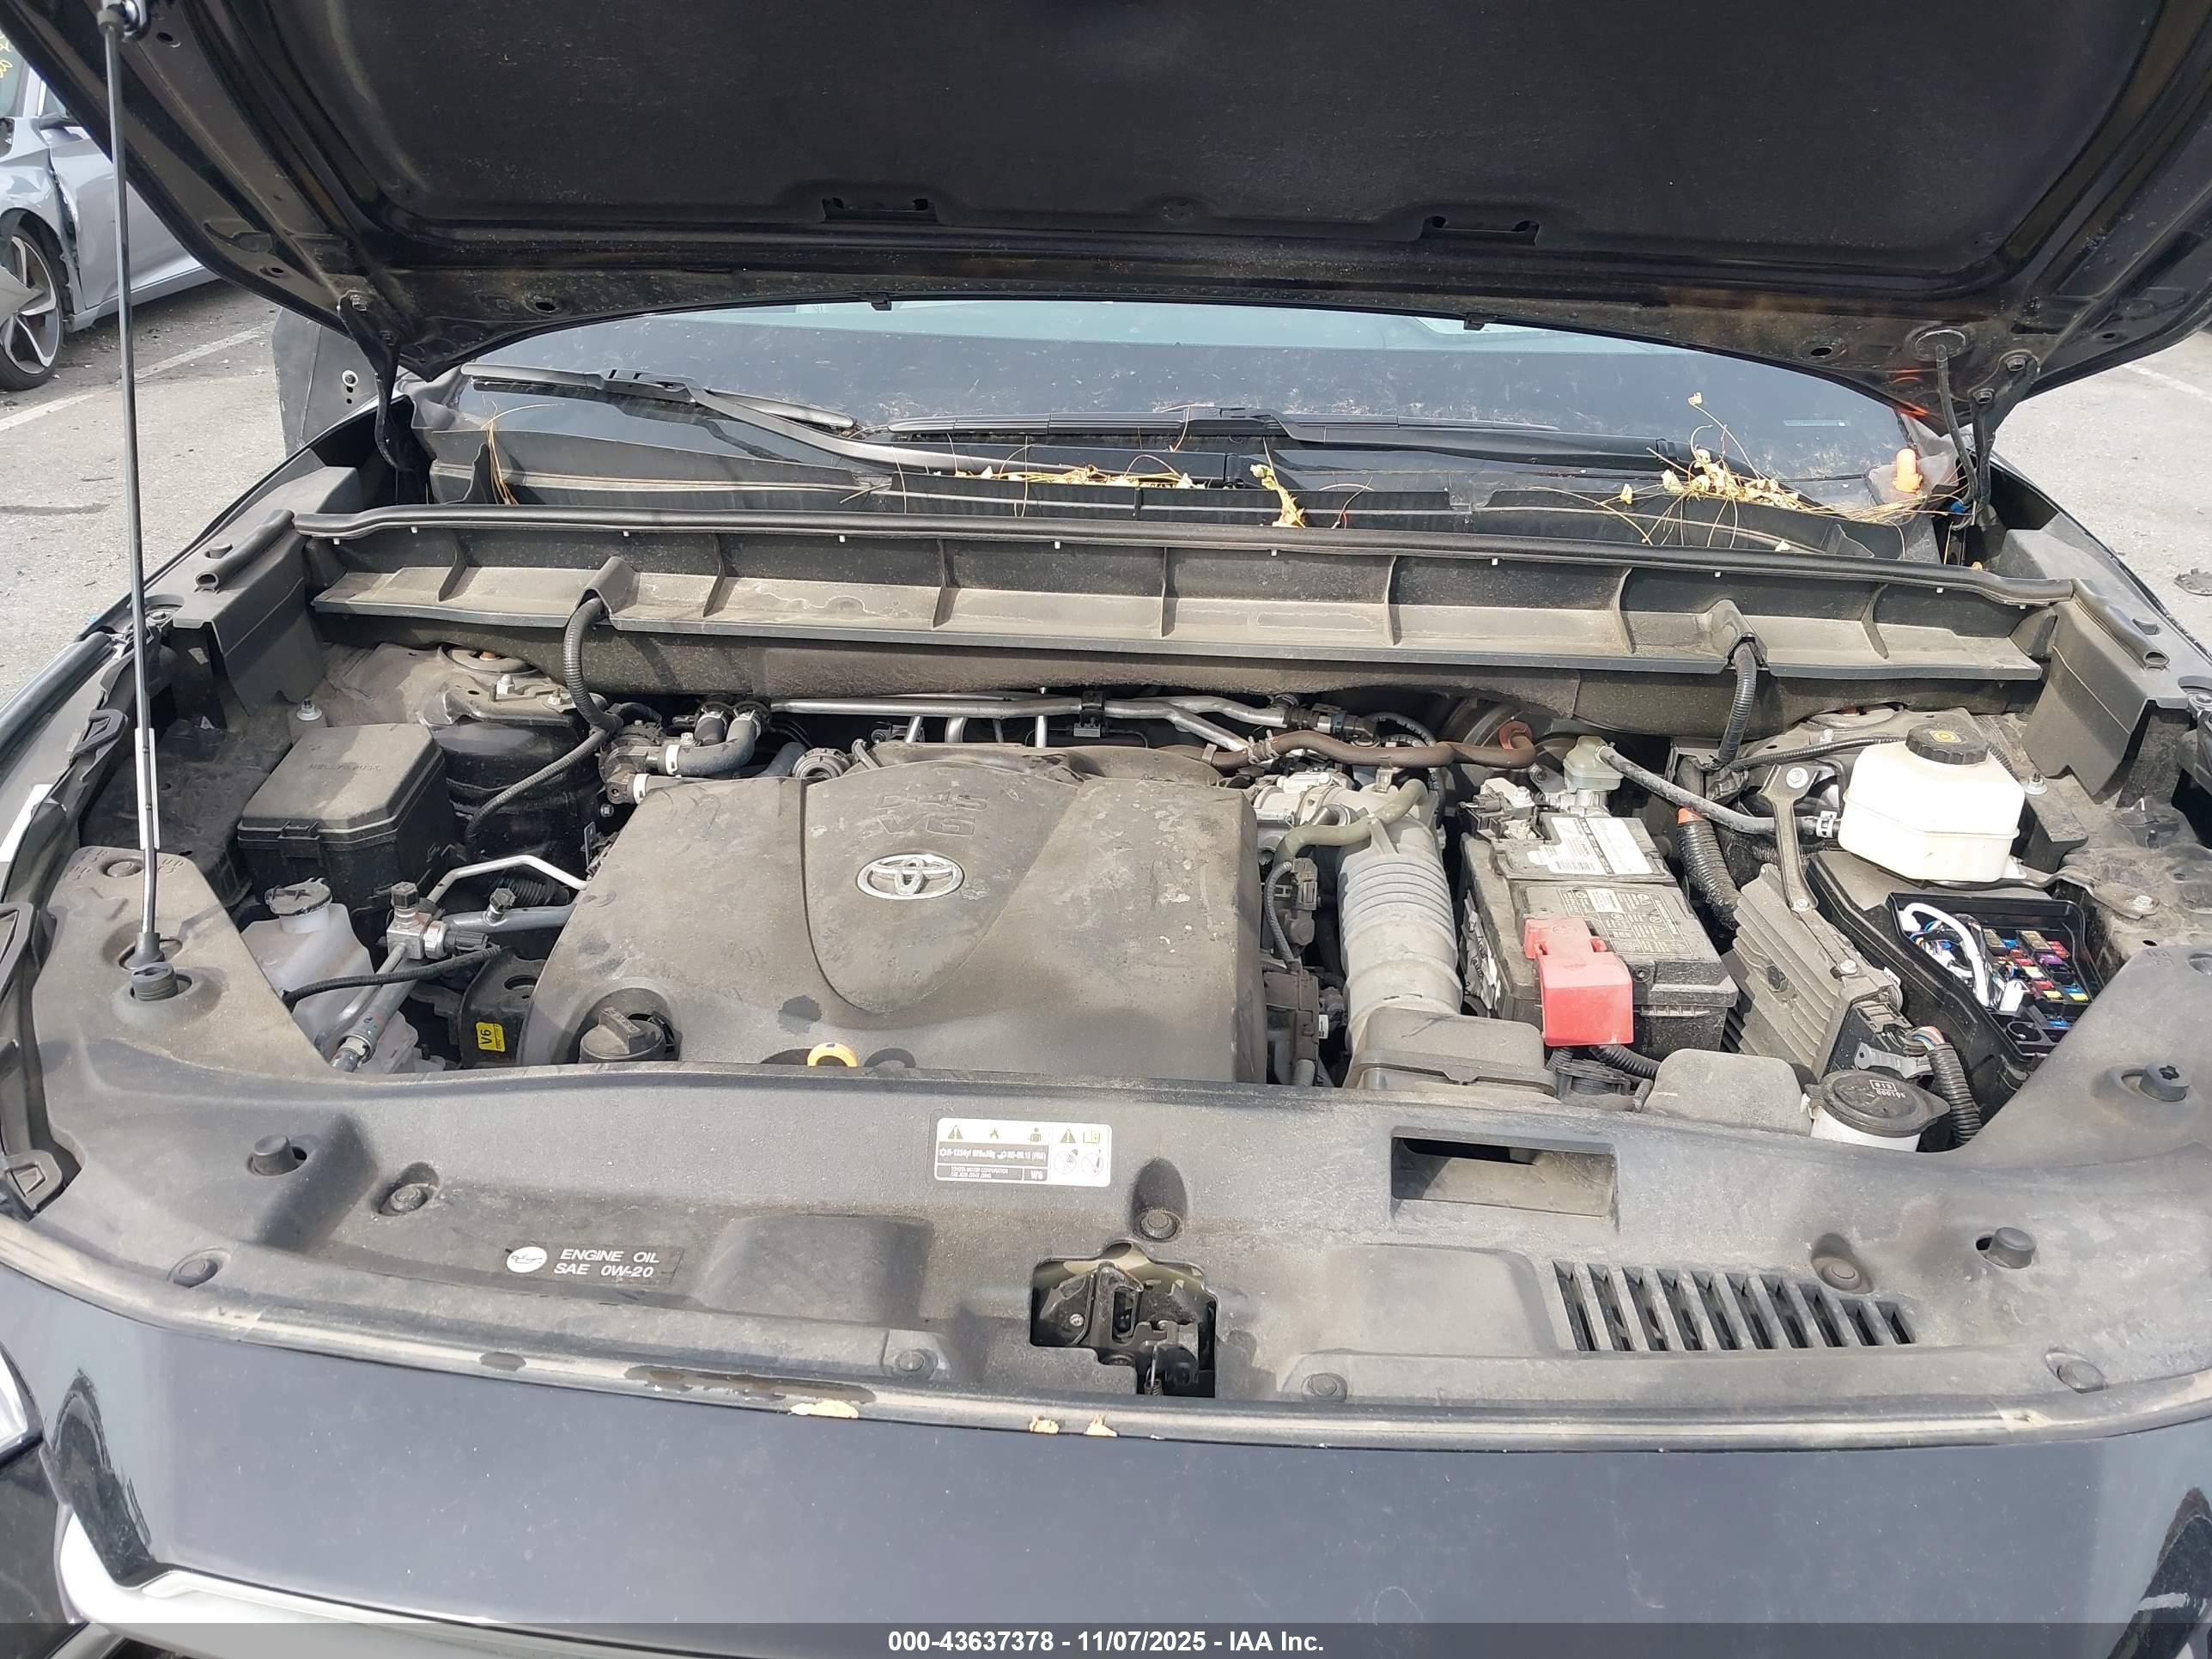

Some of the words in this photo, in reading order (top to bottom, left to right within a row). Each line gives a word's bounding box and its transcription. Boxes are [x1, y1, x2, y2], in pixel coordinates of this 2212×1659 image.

[877, 812, 975, 837] V6
[479, 1029, 492, 1045] V6
[559, 1249, 624, 1262] ENGINE
[633, 1251, 660, 1263] OIL
[553, 1262, 591, 1275] SAE
[600, 1264, 654, 1278] 0W-20
